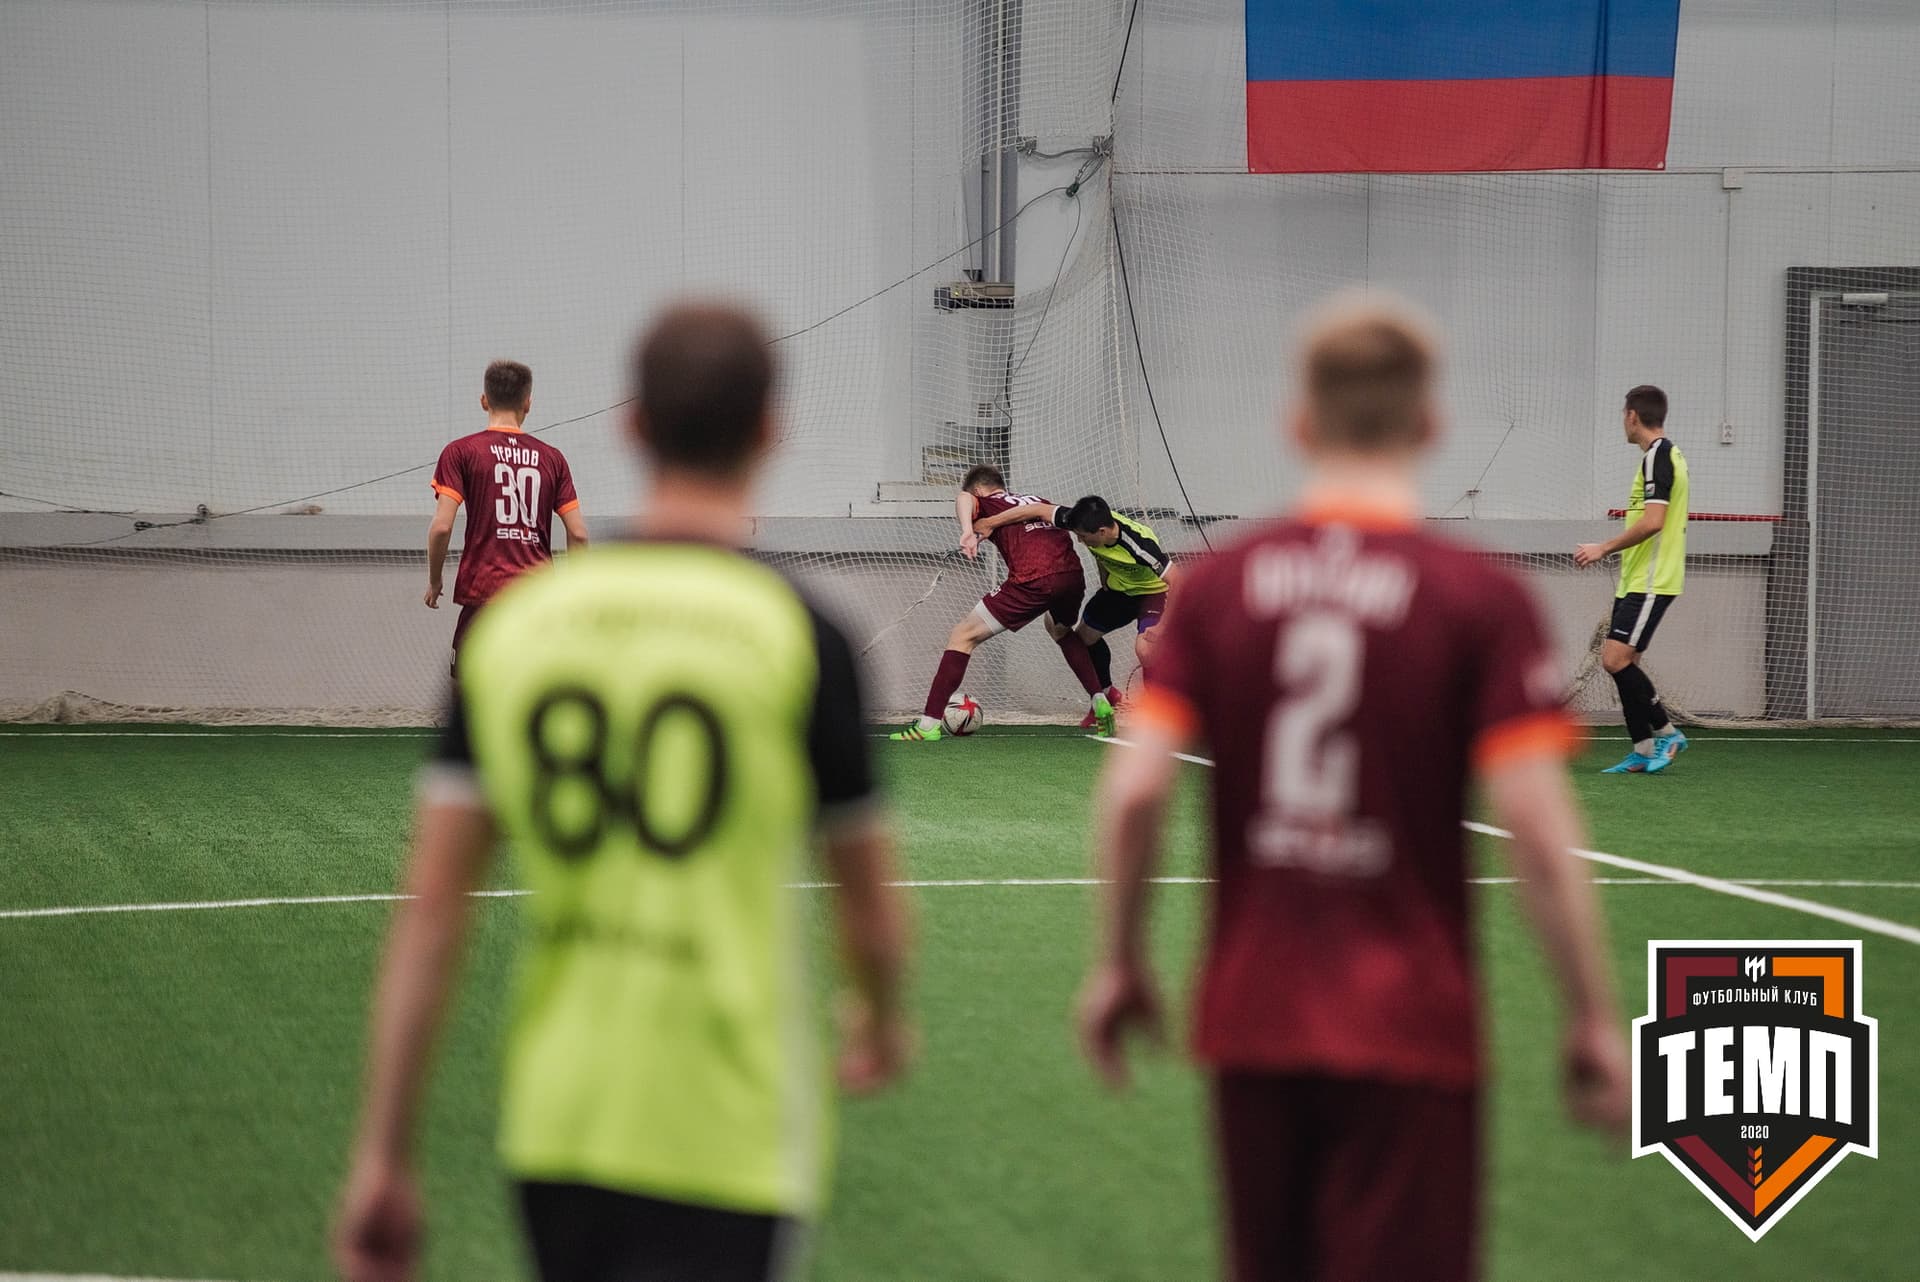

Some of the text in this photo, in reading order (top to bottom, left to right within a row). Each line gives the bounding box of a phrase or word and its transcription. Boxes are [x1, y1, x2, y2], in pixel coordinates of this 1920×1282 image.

[490, 444, 539, 466] ЧЕРНОВ
[494, 463, 541, 528] 30
[528, 686, 730, 860] 80
[1266, 610, 1364, 819] 2
